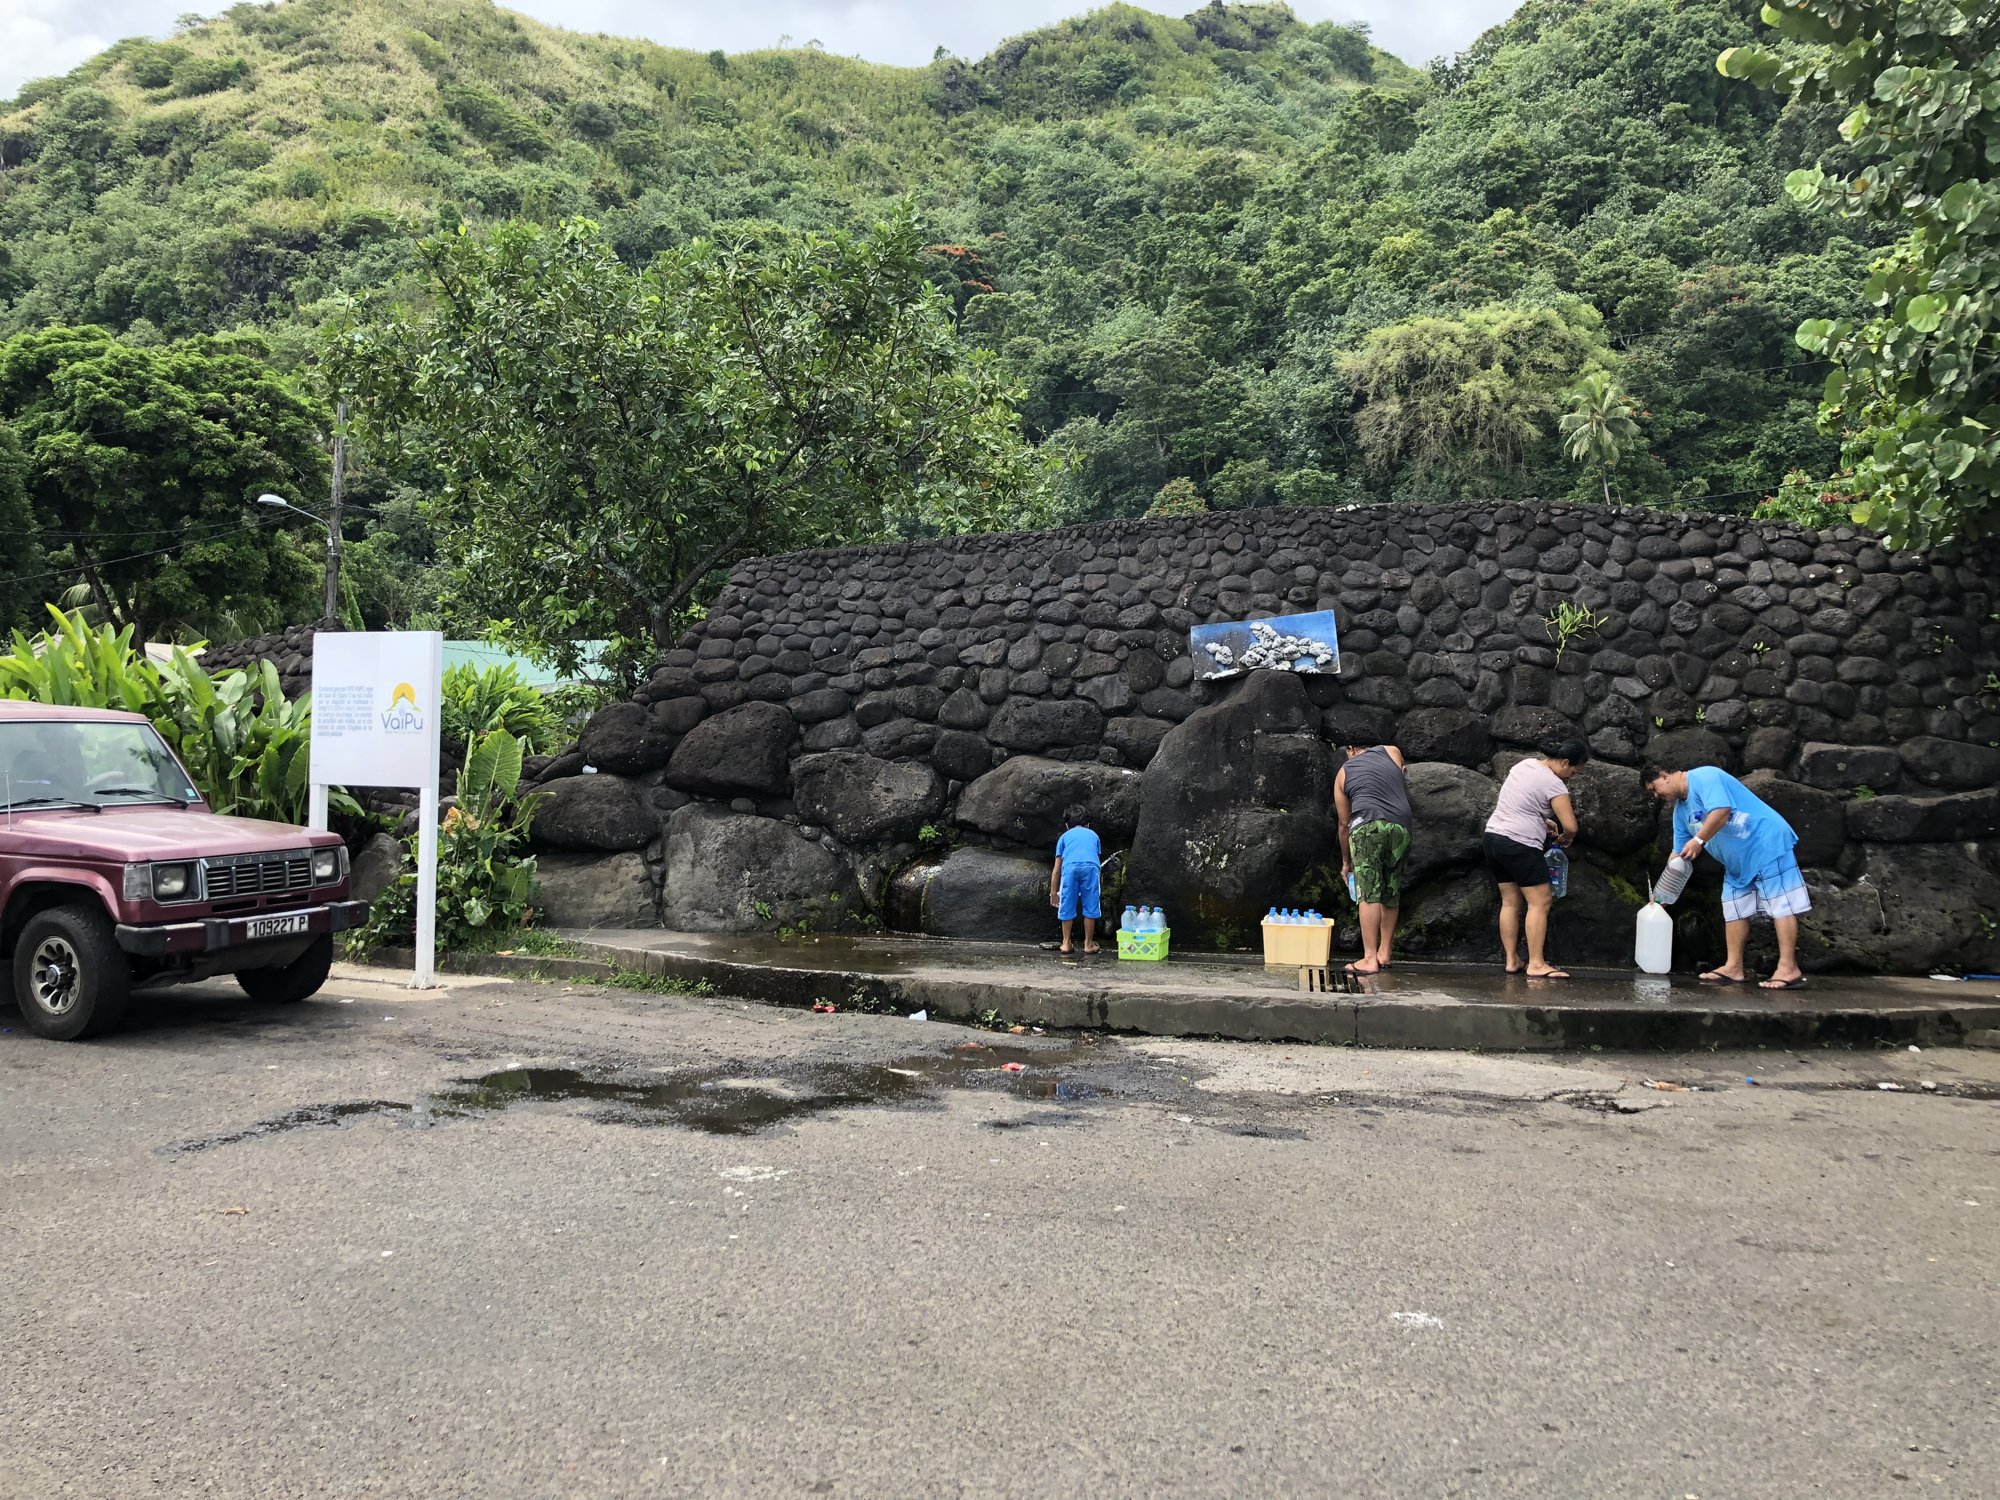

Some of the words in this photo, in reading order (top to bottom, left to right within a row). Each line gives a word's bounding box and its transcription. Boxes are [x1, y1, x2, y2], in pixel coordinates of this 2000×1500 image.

[381, 712, 424, 730] VaiPu
[252, 917, 295, 937] 109227
[298, 916, 306, 931] P
